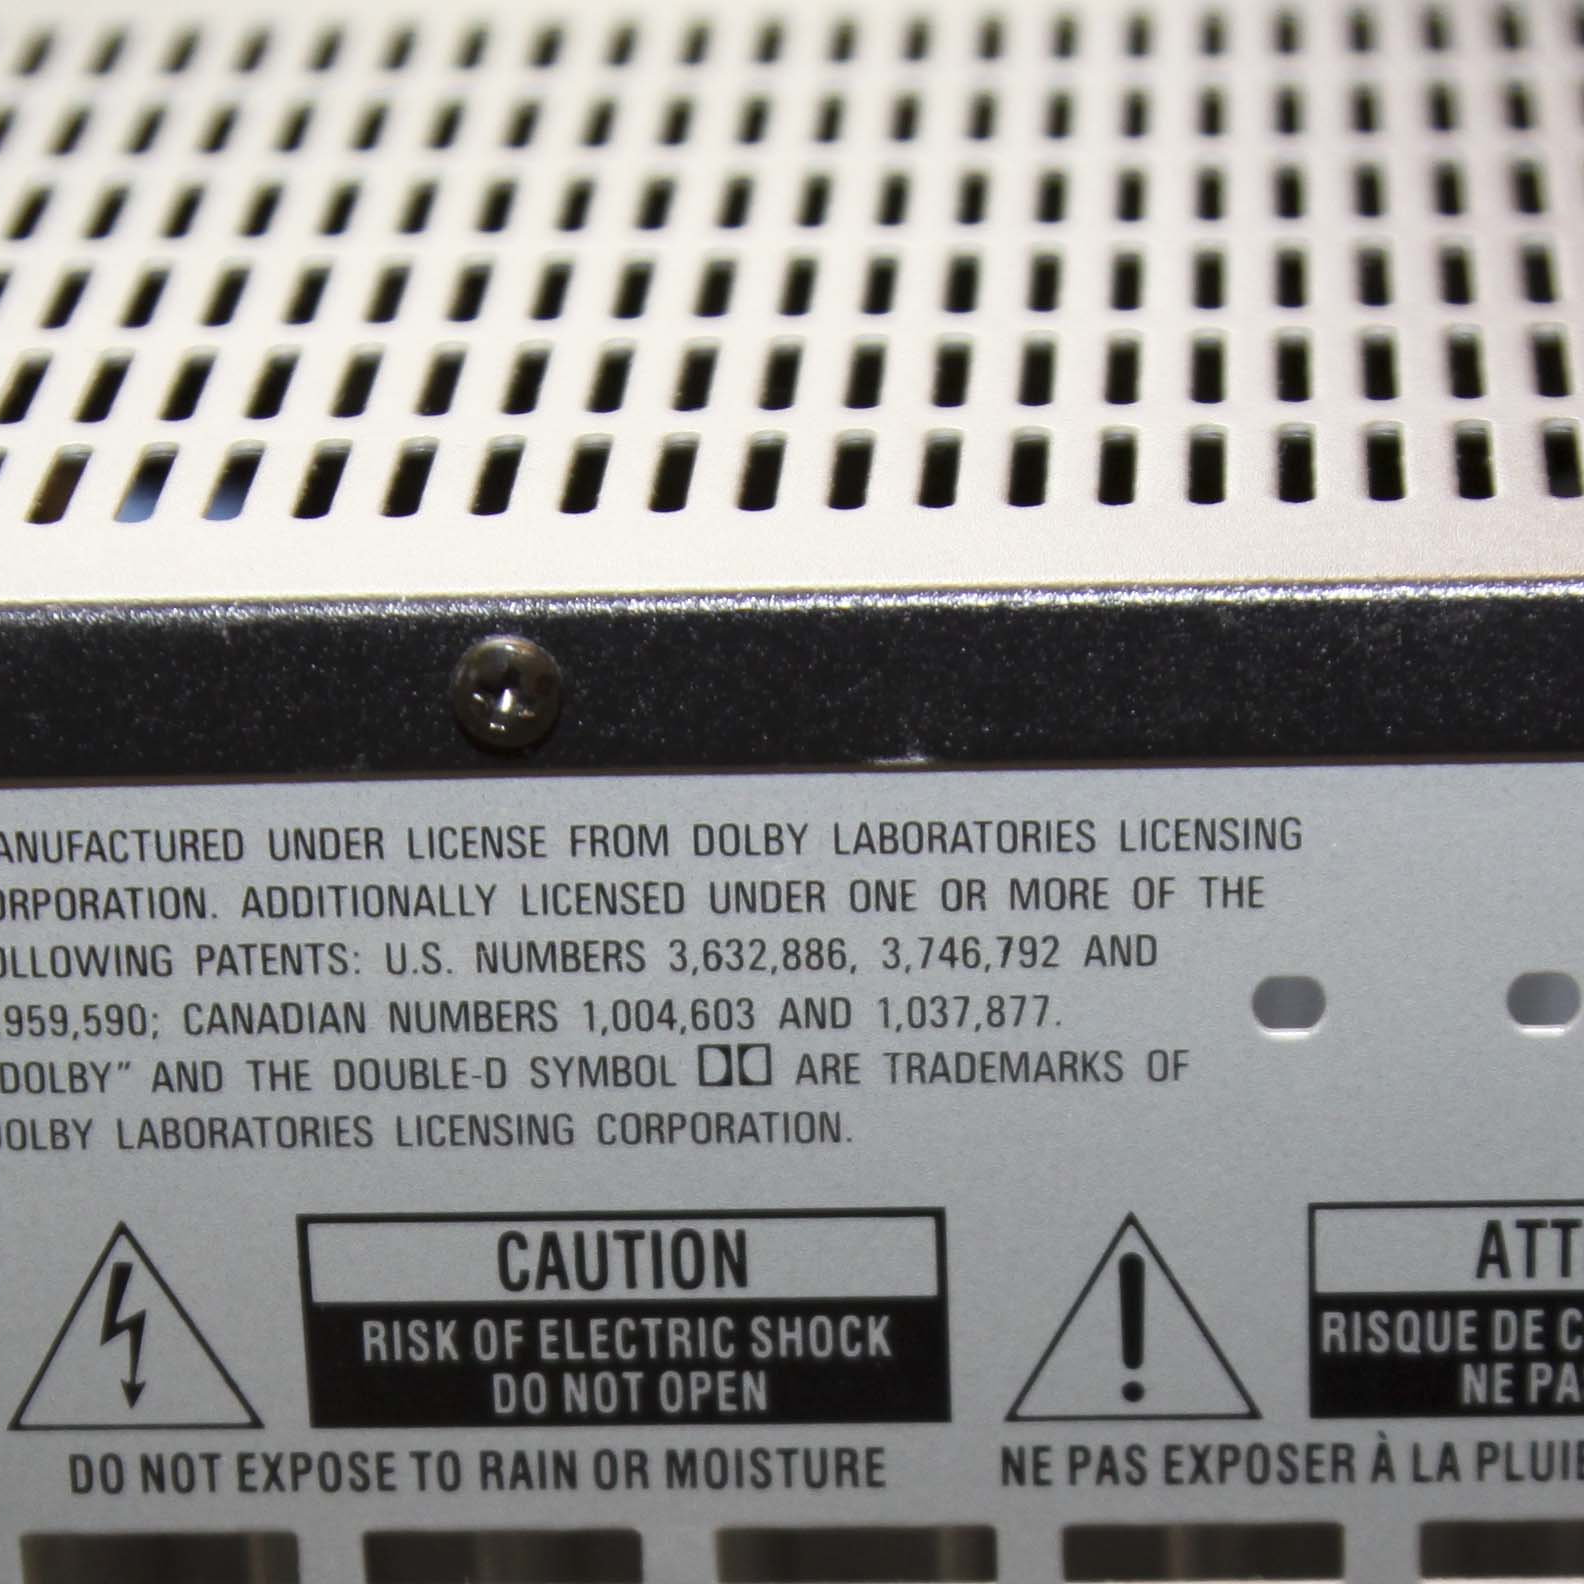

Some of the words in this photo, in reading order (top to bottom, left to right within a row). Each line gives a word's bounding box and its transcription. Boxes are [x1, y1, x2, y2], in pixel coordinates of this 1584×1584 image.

[269, 827, 384, 861] UNDER
[408, 825, 546, 860] LICENSE
[571, 824, 668, 858] FROM
[694, 823, 808, 857] DOLBY
[834, 819, 1095, 855] LABORATORIES
[1120, 817, 1301, 852] LICENSING
[242, 885, 496, 919] ADDITIONALLY
[522, 881, 684, 916] LICENSED
[710, 880, 825, 914] UNDER
[850, 880, 916, 913] ONE
[941, 879, 986, 912] OR
[1010, 878, 1108, 911] MORE
[1133, 877, 1175, 910] OF
[1199, 876, 1264, 909] THE
[196, 943, 359, 976] PATENTS:
[386, 942, 452, 976] U.S.
[476, 940, 645, 974] NUMBERS
[670, 938, 856, 976] 3,632,886,
[883, 935, 1059, 973] 3,746,792
[1084, 934, 1157, 967] AND
[184, 1002, 366, 1036] CANADIAN
[389, 1000, 558, 1034] NUMBERS
[584, 998, 754, 1036] 1,004,603
[779, 997, 851, 1029] AND
[879, 995, 1060, 1033] 1,037,877.
[152, 1061, 223, 1093] AND
[246, 1060, 311, 1092] THE
[334, 1057, 507, 1091] DOUBLE-D
[530, 1055, 676, 1089] SYMBOL
[796, 1053, 860, 1085] ARE
[883, 1050, 1123, 1084] TRADEMARKS
[1147, 1049, 1189, 1082] OF
[117, 1116, 373, 1150] LABORATORIES
[397, 1113, 574, 1147] LICENSING
[598, 1111, 851, 1145] CORPORATION.
[498, 1228, 747, 1292] CAUTION
[363, 1320, 459, 1362] RISK
[474, 1319, 523, 1361] OF
[540, 1316, 734, 1360] ELECTRIC
[751, 1315, 891, 1358] SHOCK
[1322, 1310, 1476, 1354] RISQUE
[1493, 1309, 1544, 1351] DE
[493, 1372, 547, 1415] DO
[564, 1371, 643, 1413] NOT
[660, 1371, 767, 1413] OPEN
[1463, 1363, 1513, 1404] NE
[69, 1453, 124, 1495] DO
[140, 1452, 221, 1494] NOT
[237, 1451, 396, 1493] EXPOSE
[410, 1450, 461, 1492] TO
[480, 1450, 577, 1490] RAIN
[594, 1449, 649, 1491] OR
[666, 1447, 885, 1490] MOISTURE
[1001, 1446, 1052, 1487] NE
[1068, 1444, 1147, 1487] PAS
[1164, 1443, 1355, 1485] EXPOSER
[1371, 1431, 1395, 1483] À
[1412, 1442, 1460, 1483] LA
